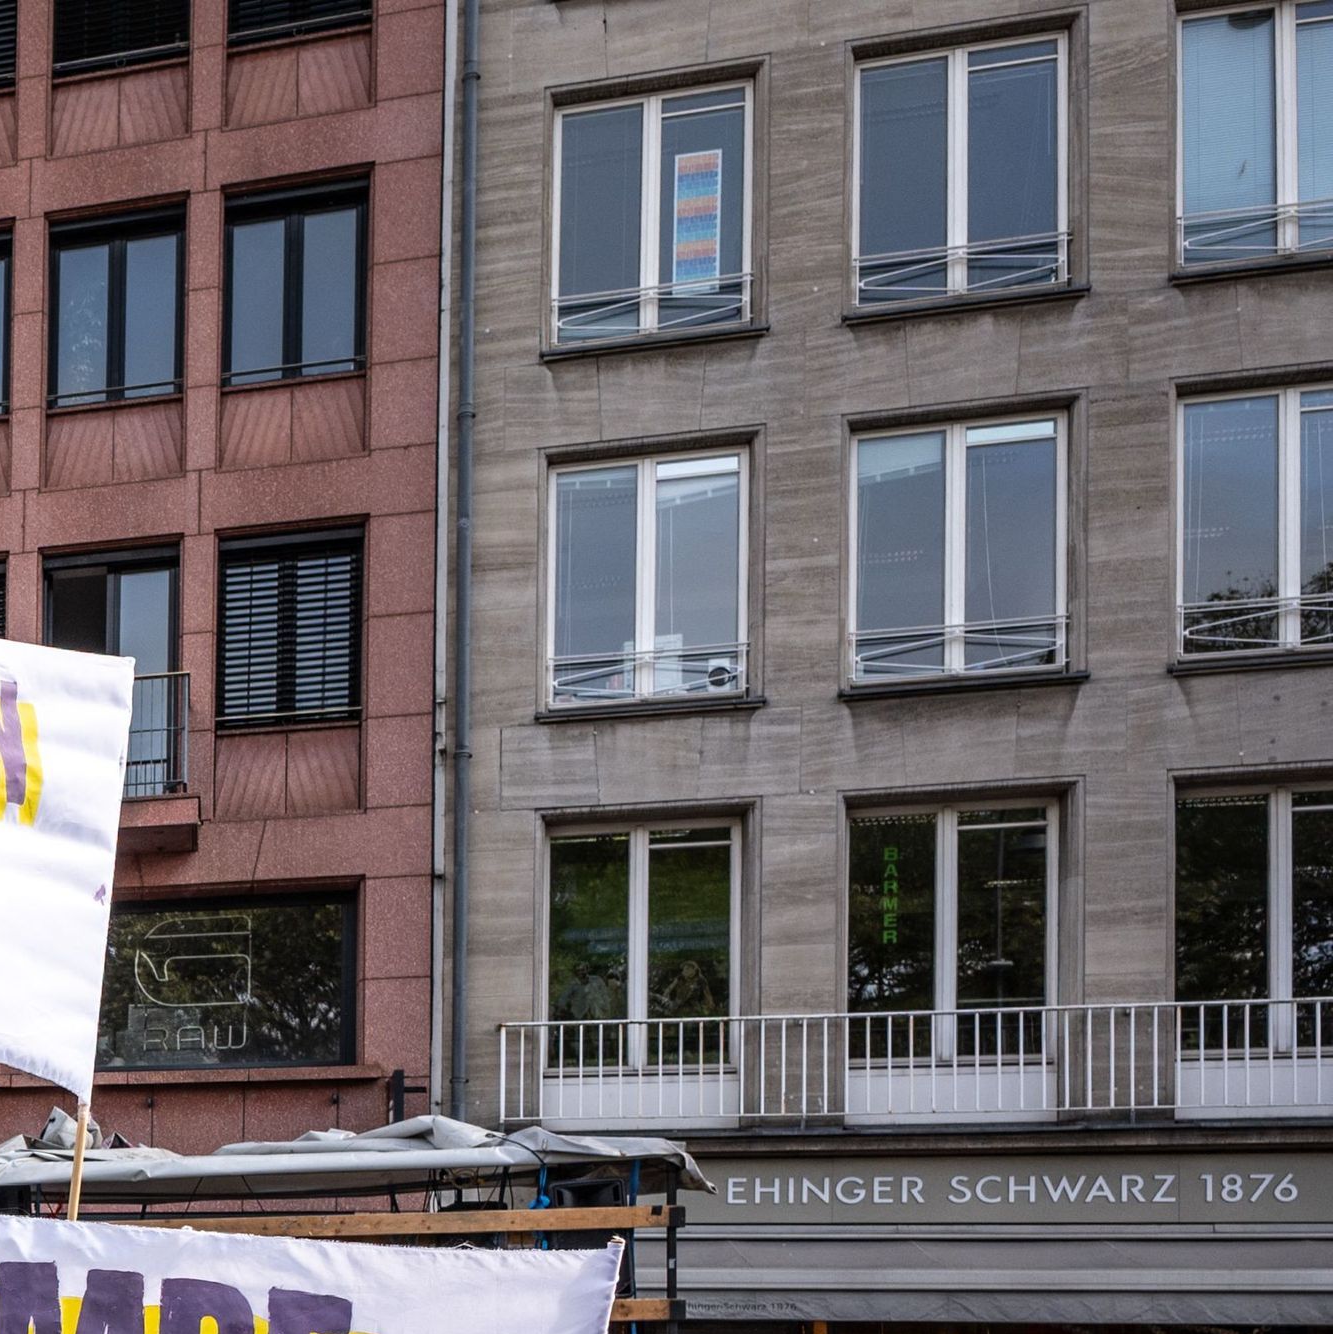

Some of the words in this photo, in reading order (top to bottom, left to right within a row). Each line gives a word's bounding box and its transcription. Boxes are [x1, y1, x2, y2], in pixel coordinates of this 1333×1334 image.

[883, 847, 900, 944] BARMER
[143, 1022, 247, 1051] RAW
[726, 1176, 925, 1205] EHINGER
[948, 1174, 1177, 1205] SCHWARZ
[1200, 1172, 1299, 1203] 1876
